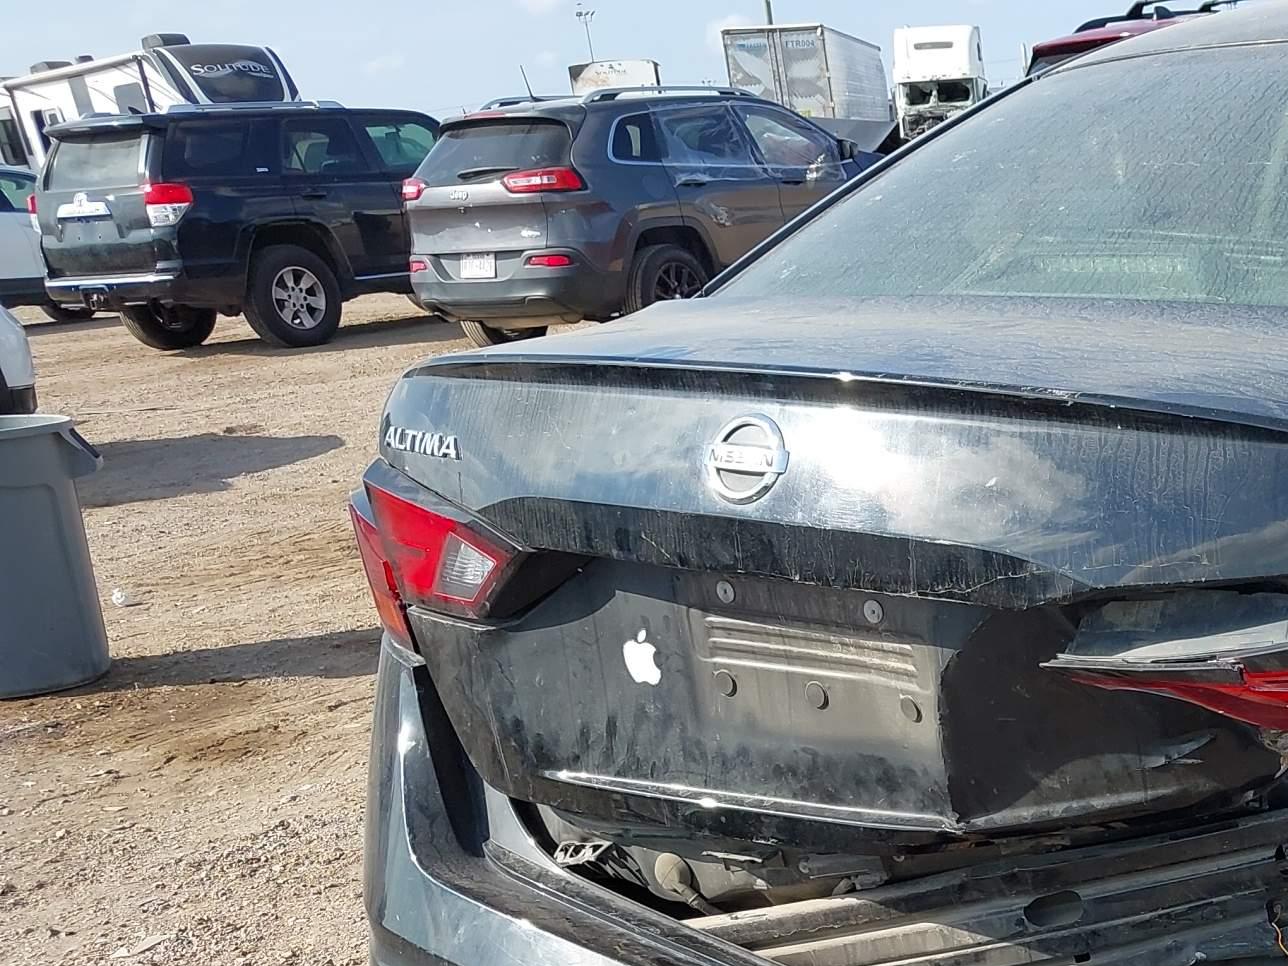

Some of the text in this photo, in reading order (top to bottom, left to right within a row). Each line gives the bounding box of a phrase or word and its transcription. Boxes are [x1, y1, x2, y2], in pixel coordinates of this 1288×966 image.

[449, 189, 469, 201] Jeep
[383, 425, 463, 461] ALTIMA
[709, 448, 774, 468] NISSN
